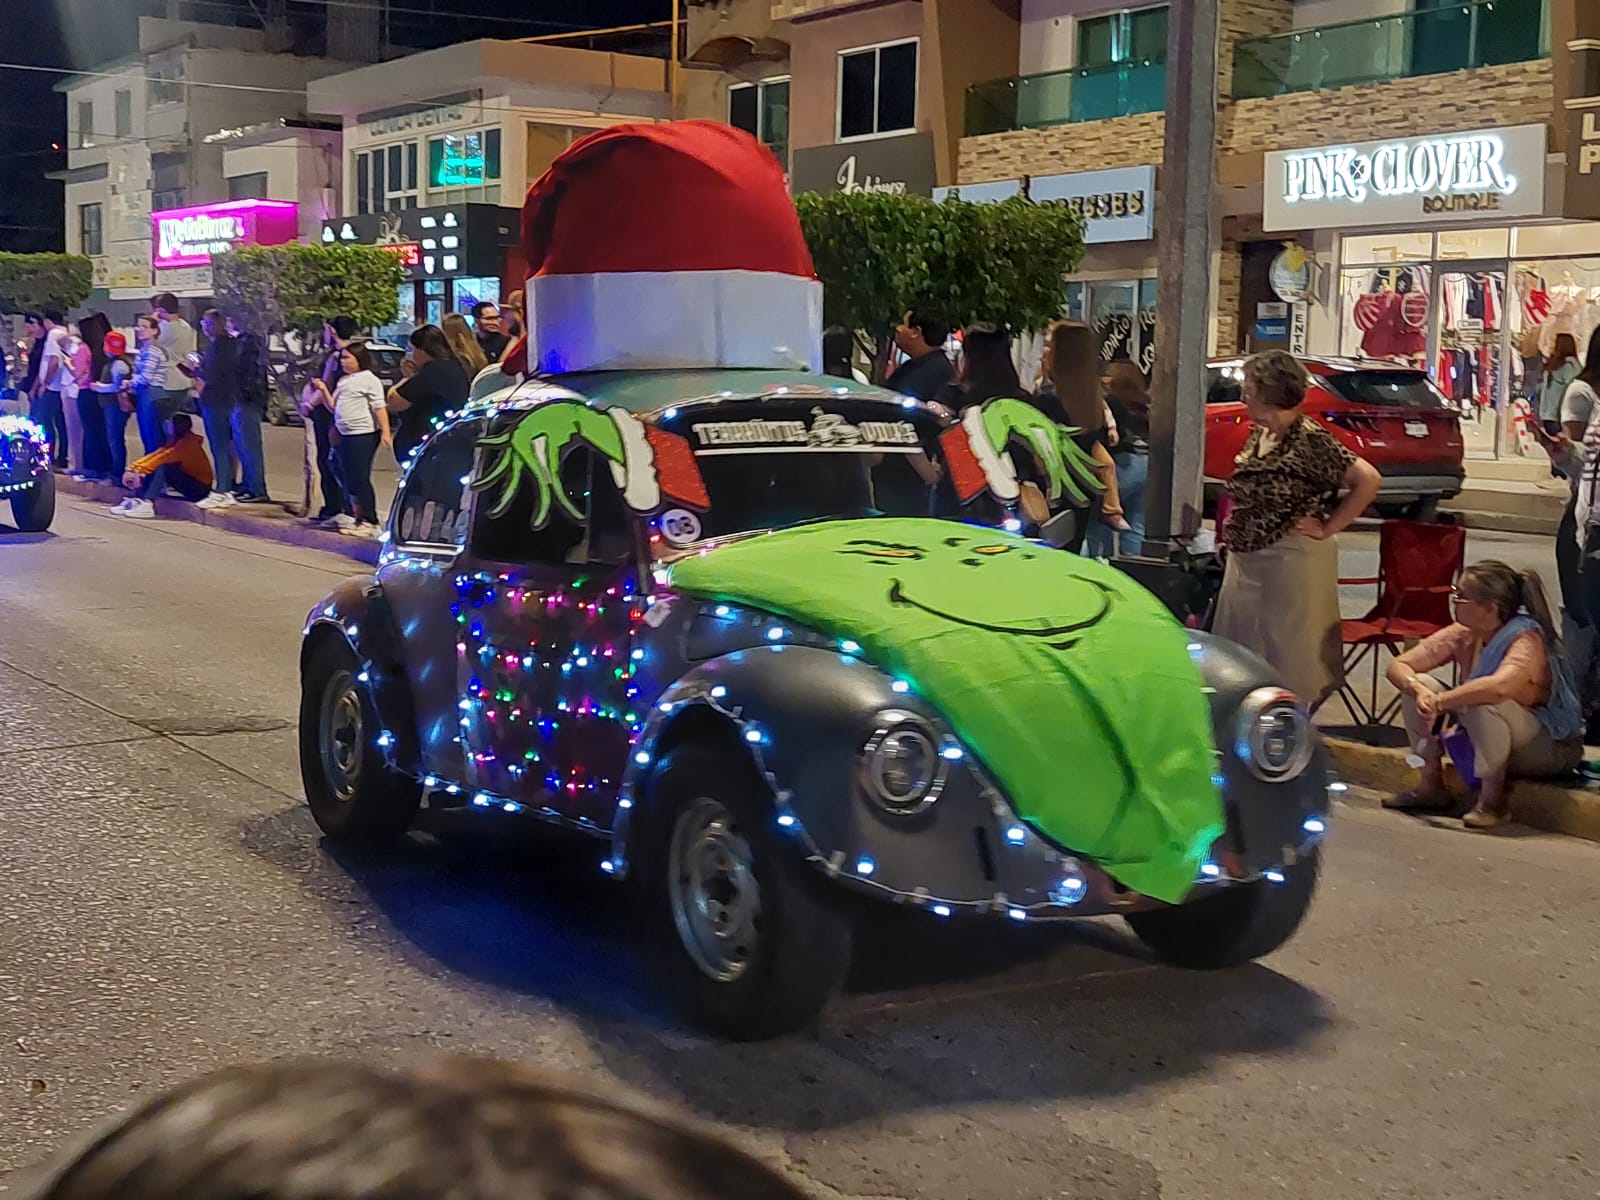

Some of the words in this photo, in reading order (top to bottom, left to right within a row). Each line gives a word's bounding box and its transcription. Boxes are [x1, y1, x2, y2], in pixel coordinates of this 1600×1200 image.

[1283, 150, 1367, 203] PINK
[1370, 136, 1517, 194] CLOVER
[1422, 194, 1500, 213] BOUTIQUE
